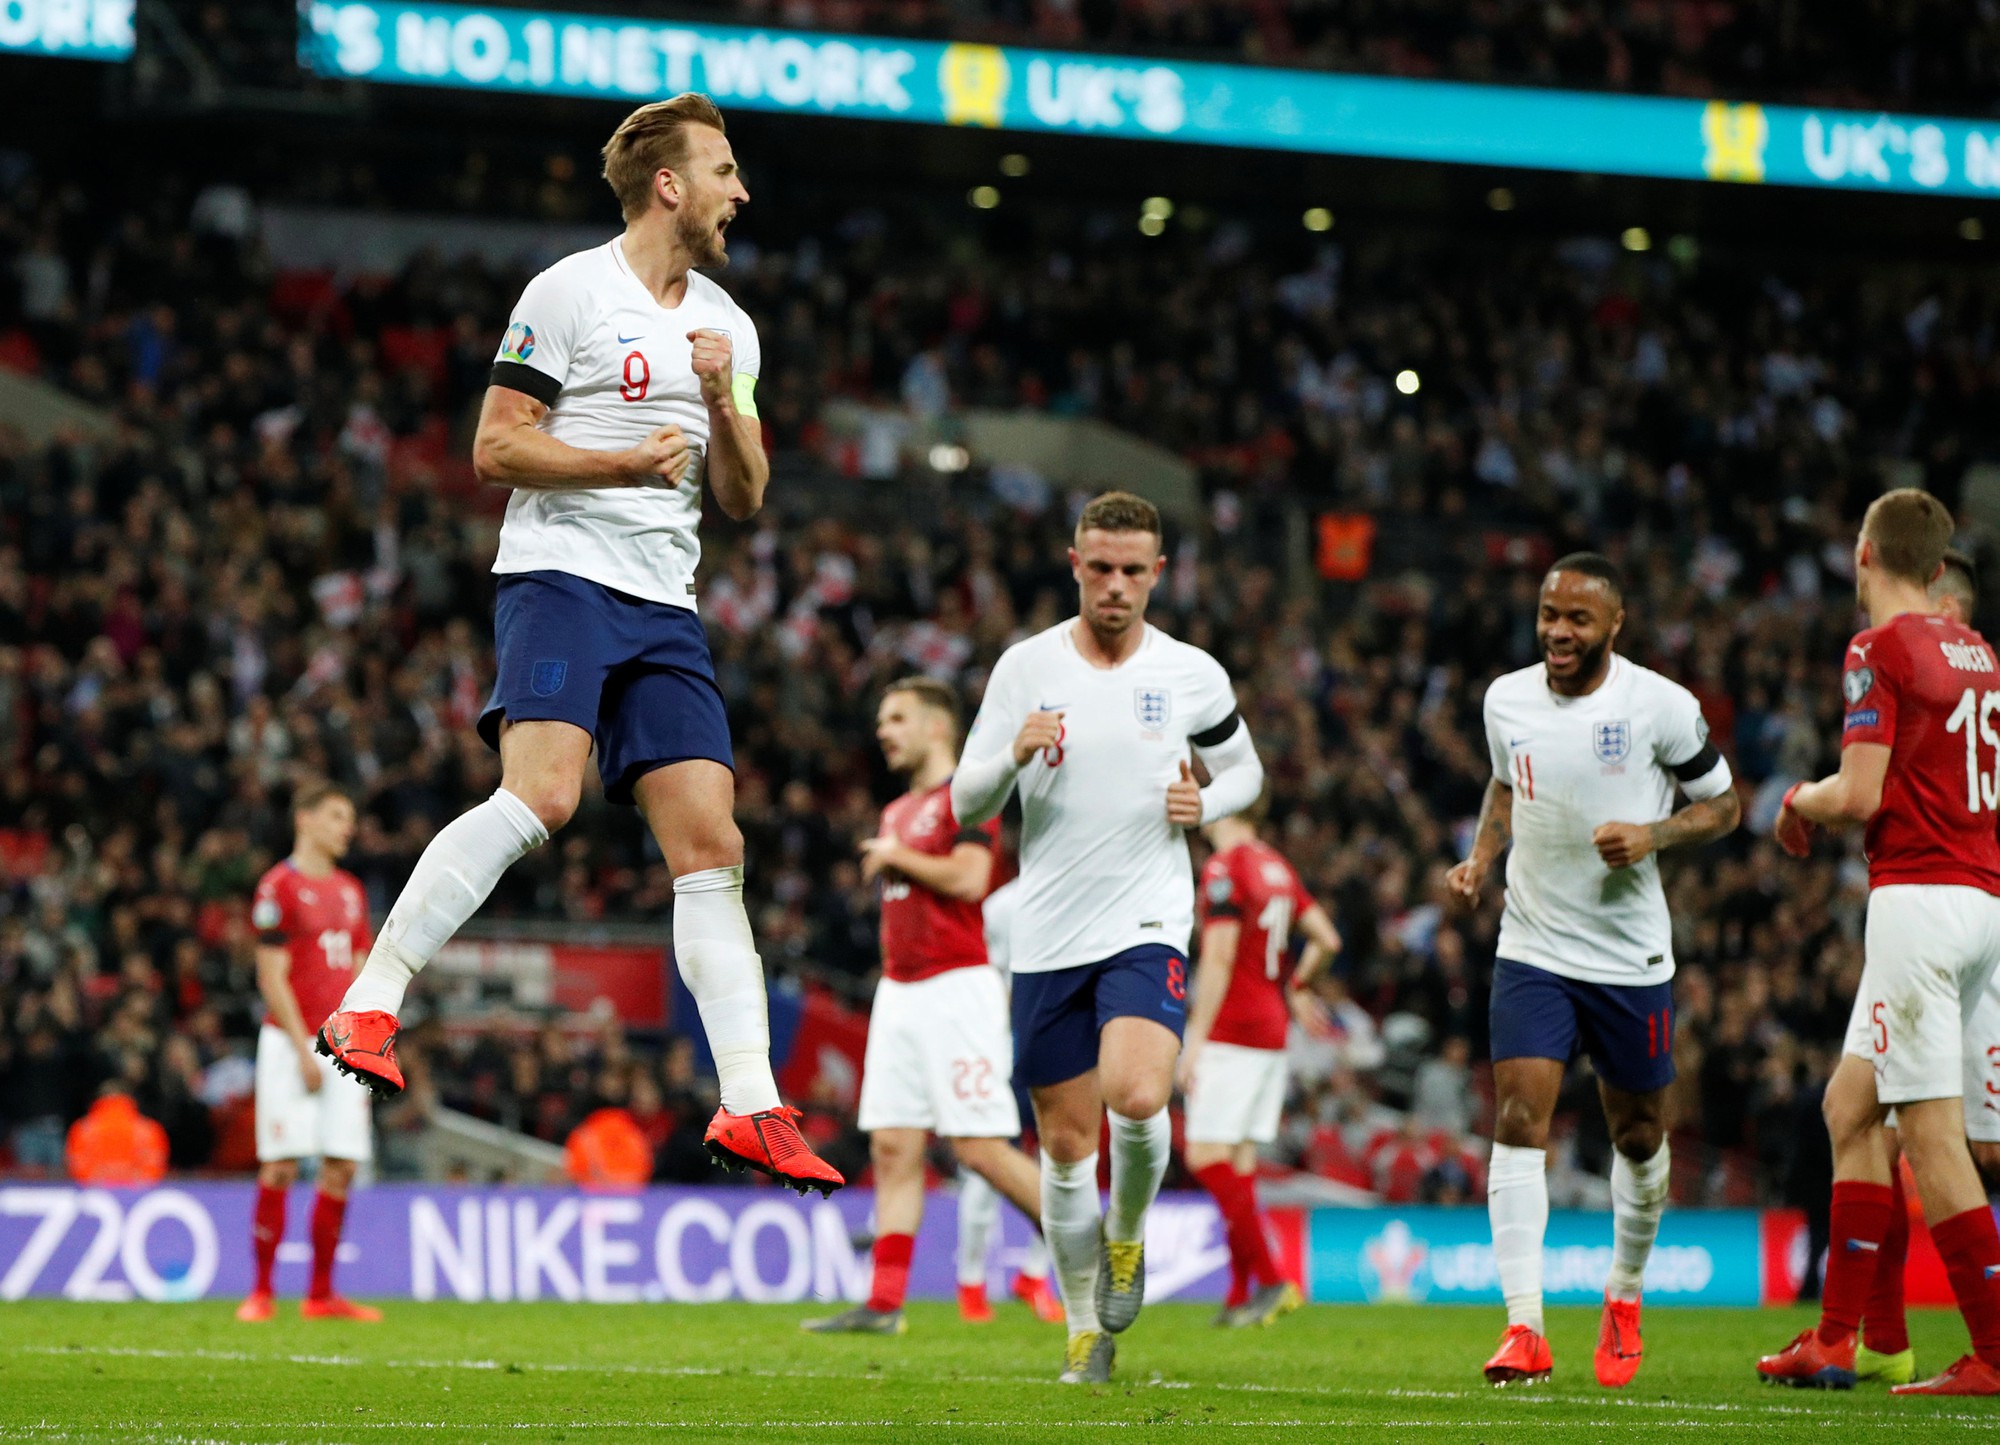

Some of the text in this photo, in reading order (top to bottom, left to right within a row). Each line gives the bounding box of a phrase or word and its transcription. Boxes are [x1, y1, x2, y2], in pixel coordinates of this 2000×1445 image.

[561, 23, 914, 110] NETWORK
[619, 350, 650, 402] 9
[1515, 753, 1535, 801] 11
[1166, 957, 1186, 1000] 8
[1648, 1008, 1670, 1058] 11
[951, 1057, 993, 1101] 22
[0, 1187, 220, 1303] 720
